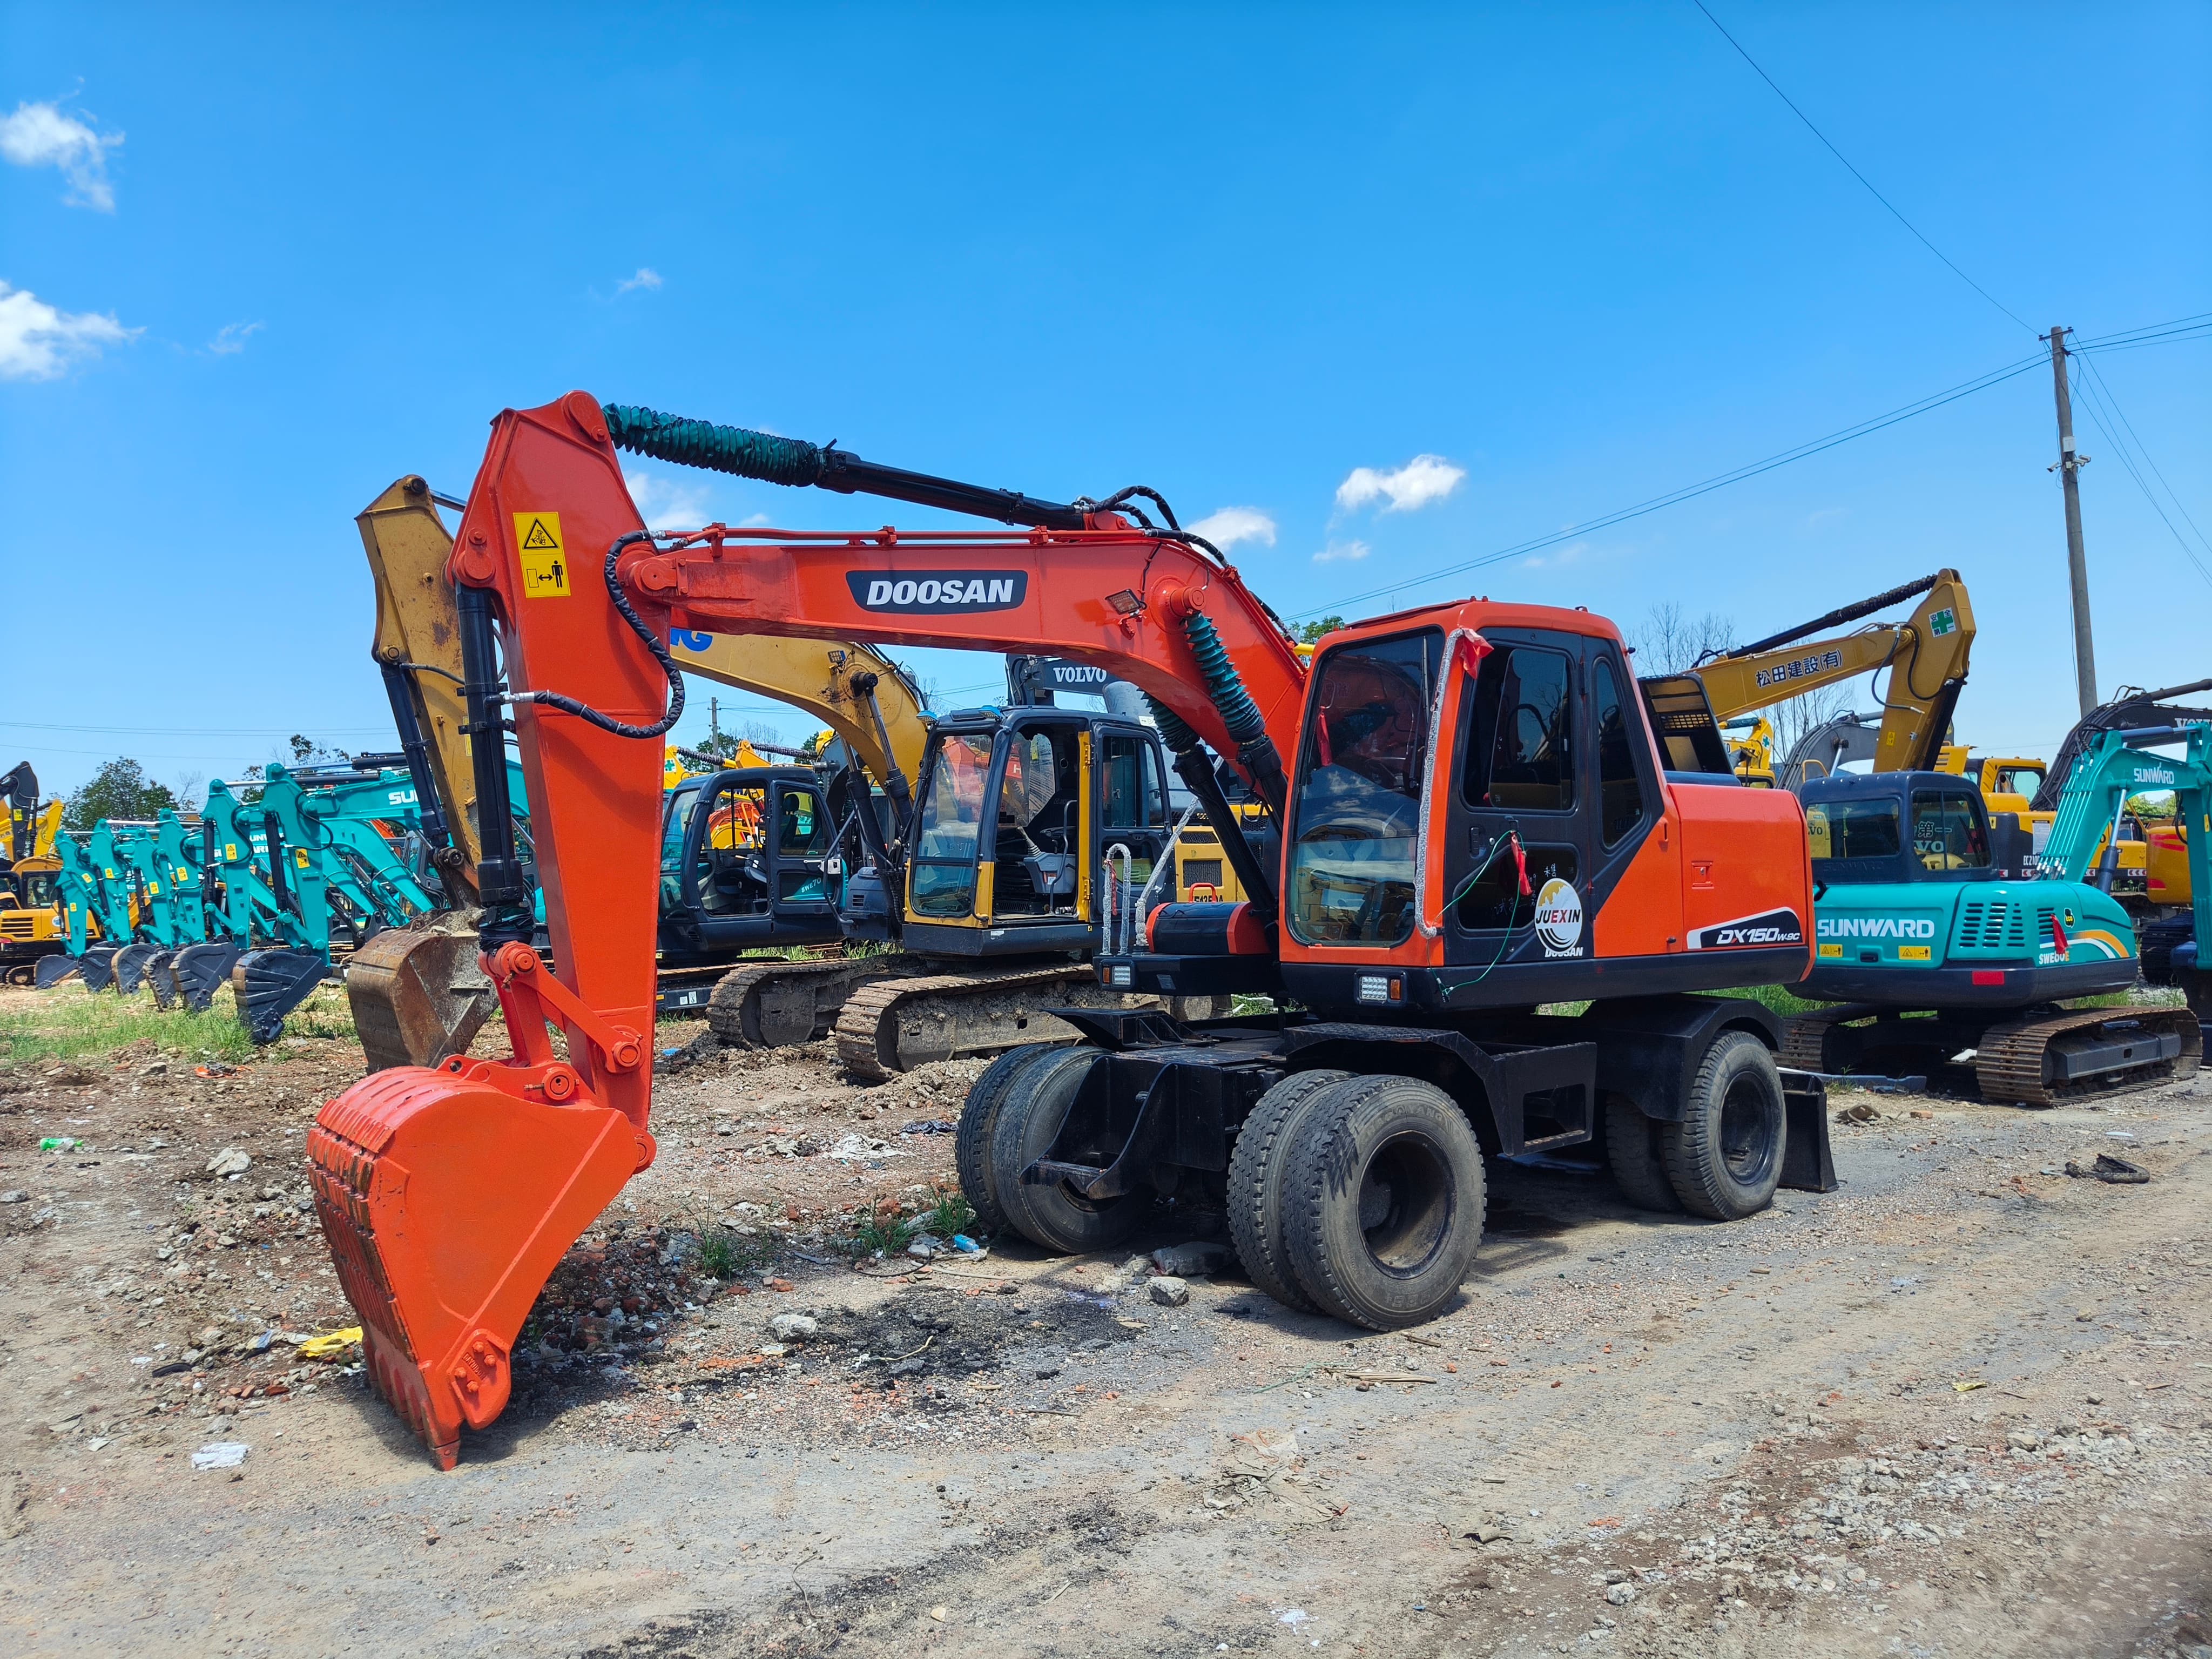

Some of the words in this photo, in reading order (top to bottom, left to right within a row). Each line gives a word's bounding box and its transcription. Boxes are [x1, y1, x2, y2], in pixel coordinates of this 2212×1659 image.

[866, 580, 1014, 605] DOOSAN
[1053, 666, 1107, 683] VOLVO
[1756, 649, 1843, 688] 松田建設(有)
[2134, 762, 2175, 784] SUNWARD
[1536, 909, 1581, 924] JUEXIN
[1817, 919, 1935, 938] SUNWARD
